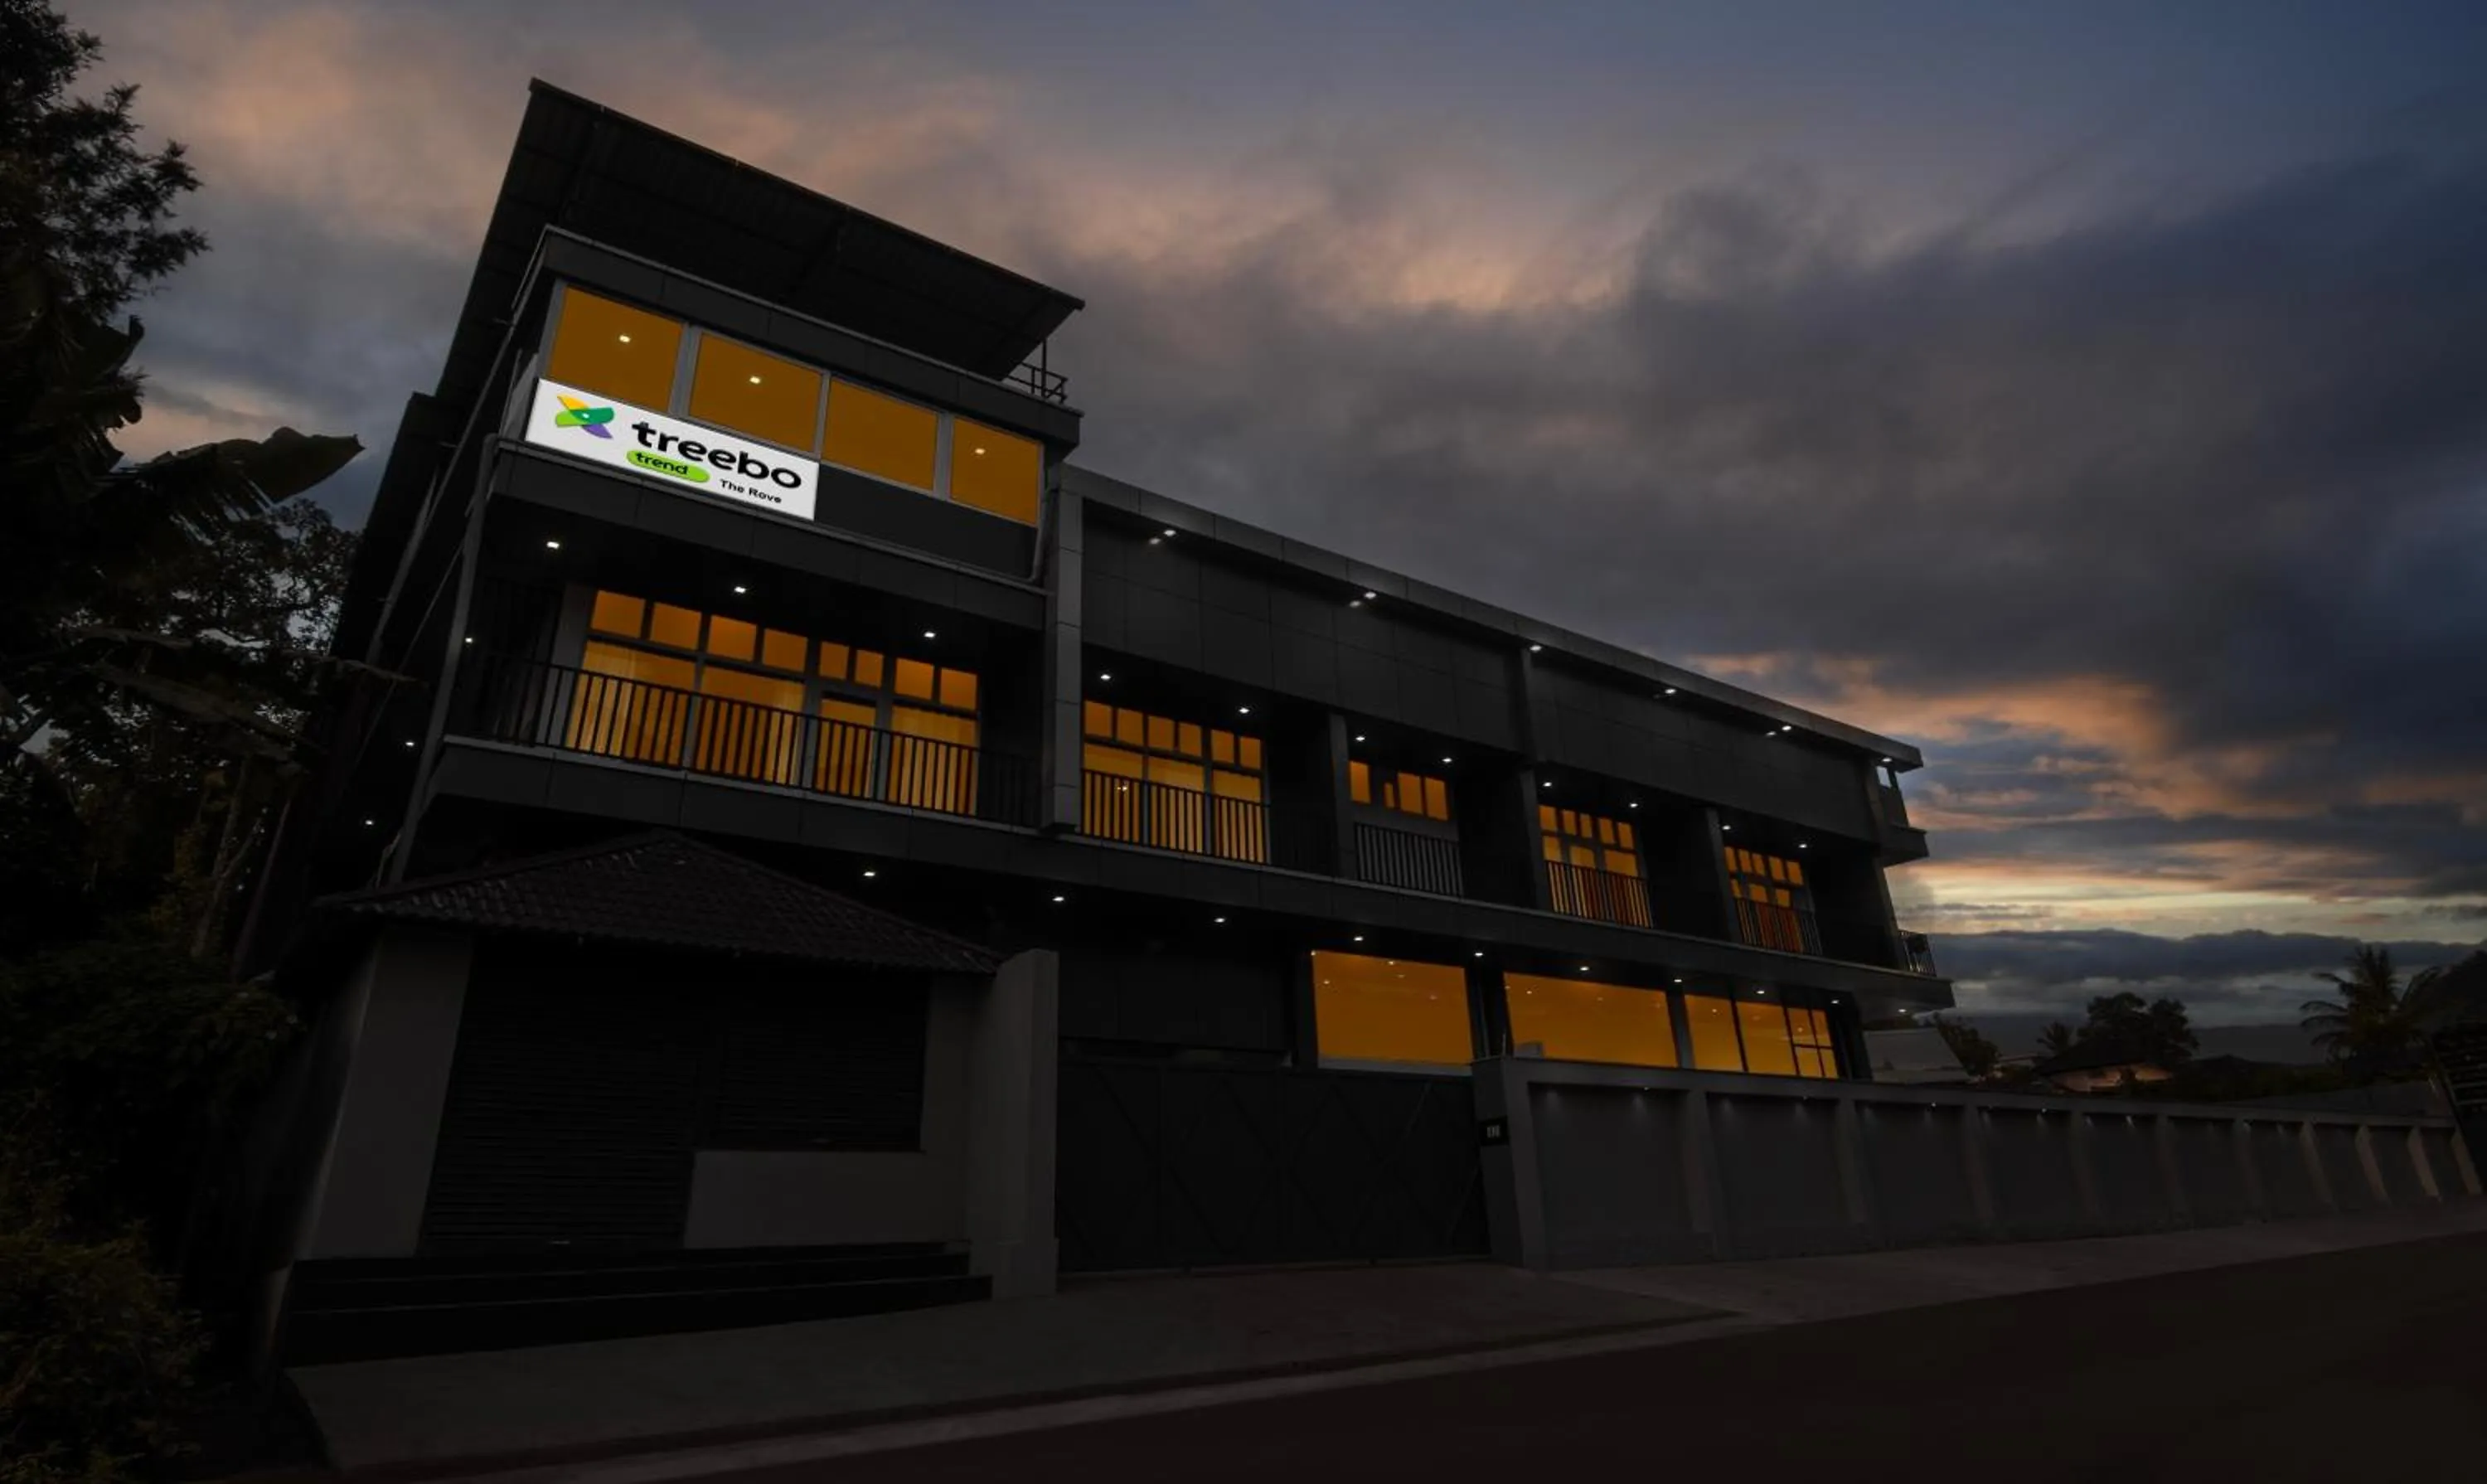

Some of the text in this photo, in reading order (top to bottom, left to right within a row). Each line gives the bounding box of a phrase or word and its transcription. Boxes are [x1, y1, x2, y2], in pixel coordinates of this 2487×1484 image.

[632, 421, 802, 488] treebo
[635, 453, 689, 475] trend
[720, 478, 782, 503] The Rove
